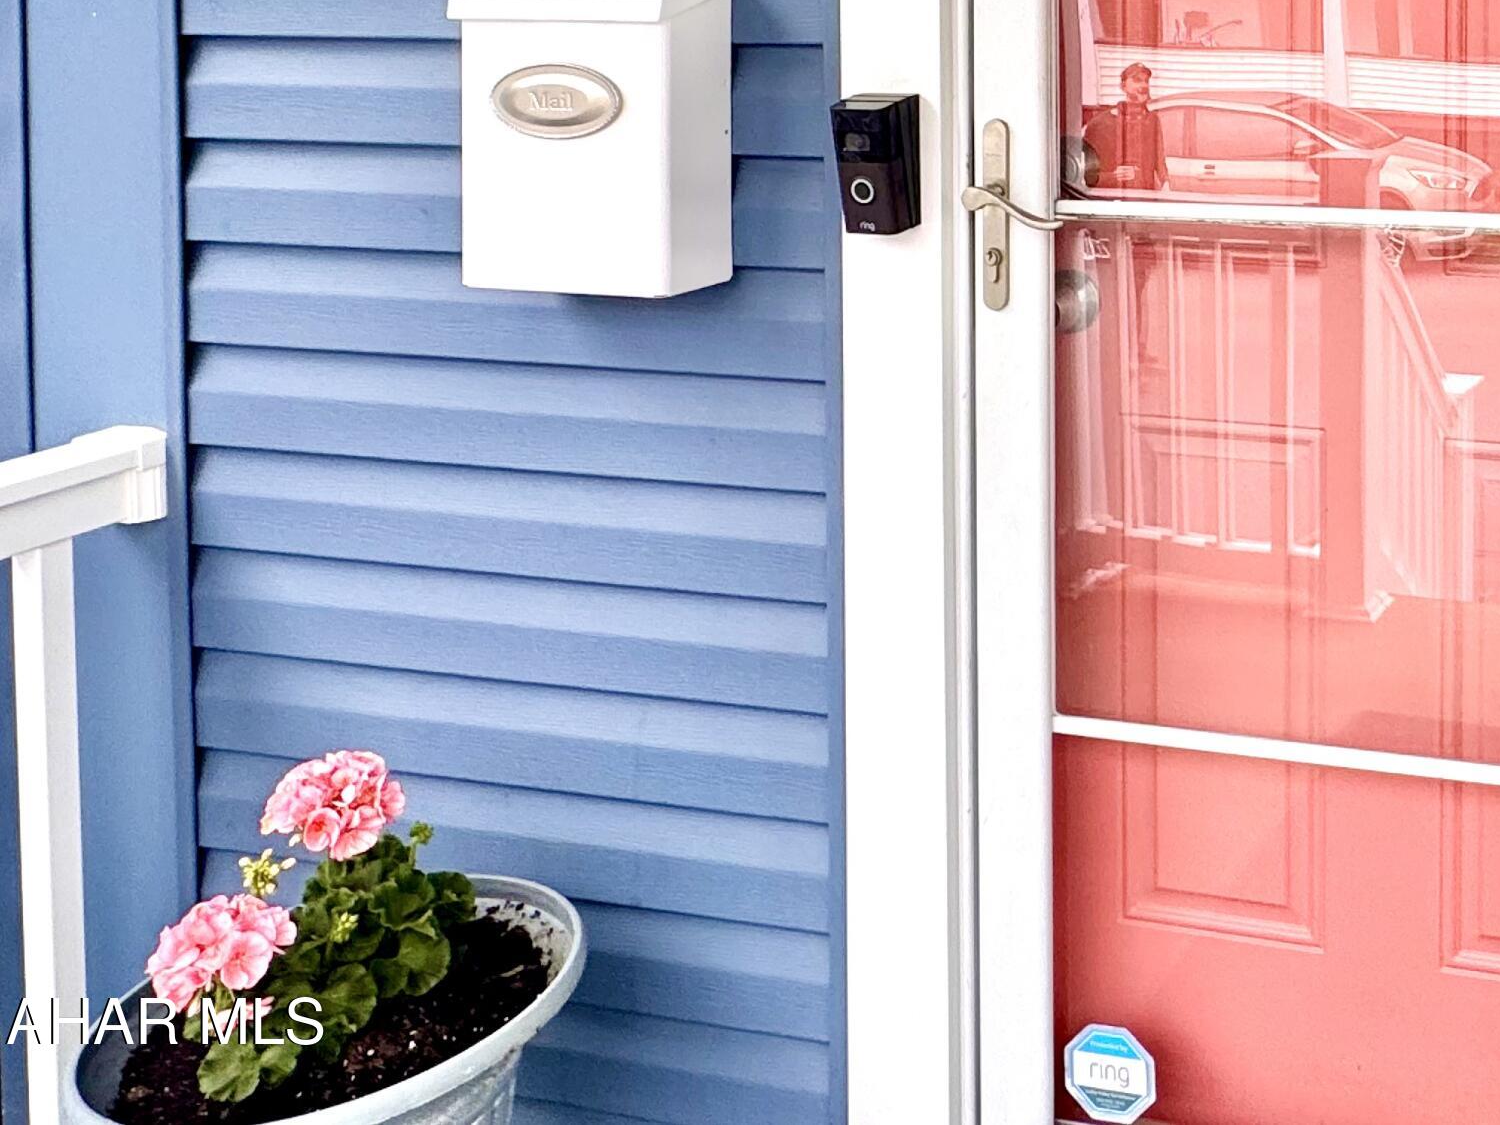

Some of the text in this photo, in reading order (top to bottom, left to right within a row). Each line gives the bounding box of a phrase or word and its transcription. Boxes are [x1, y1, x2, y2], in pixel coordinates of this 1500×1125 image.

[528, 90, 574, 112] Mail
[859, 220, 876, 232] ring
[1089, 1062, 1130, 1088] ring
